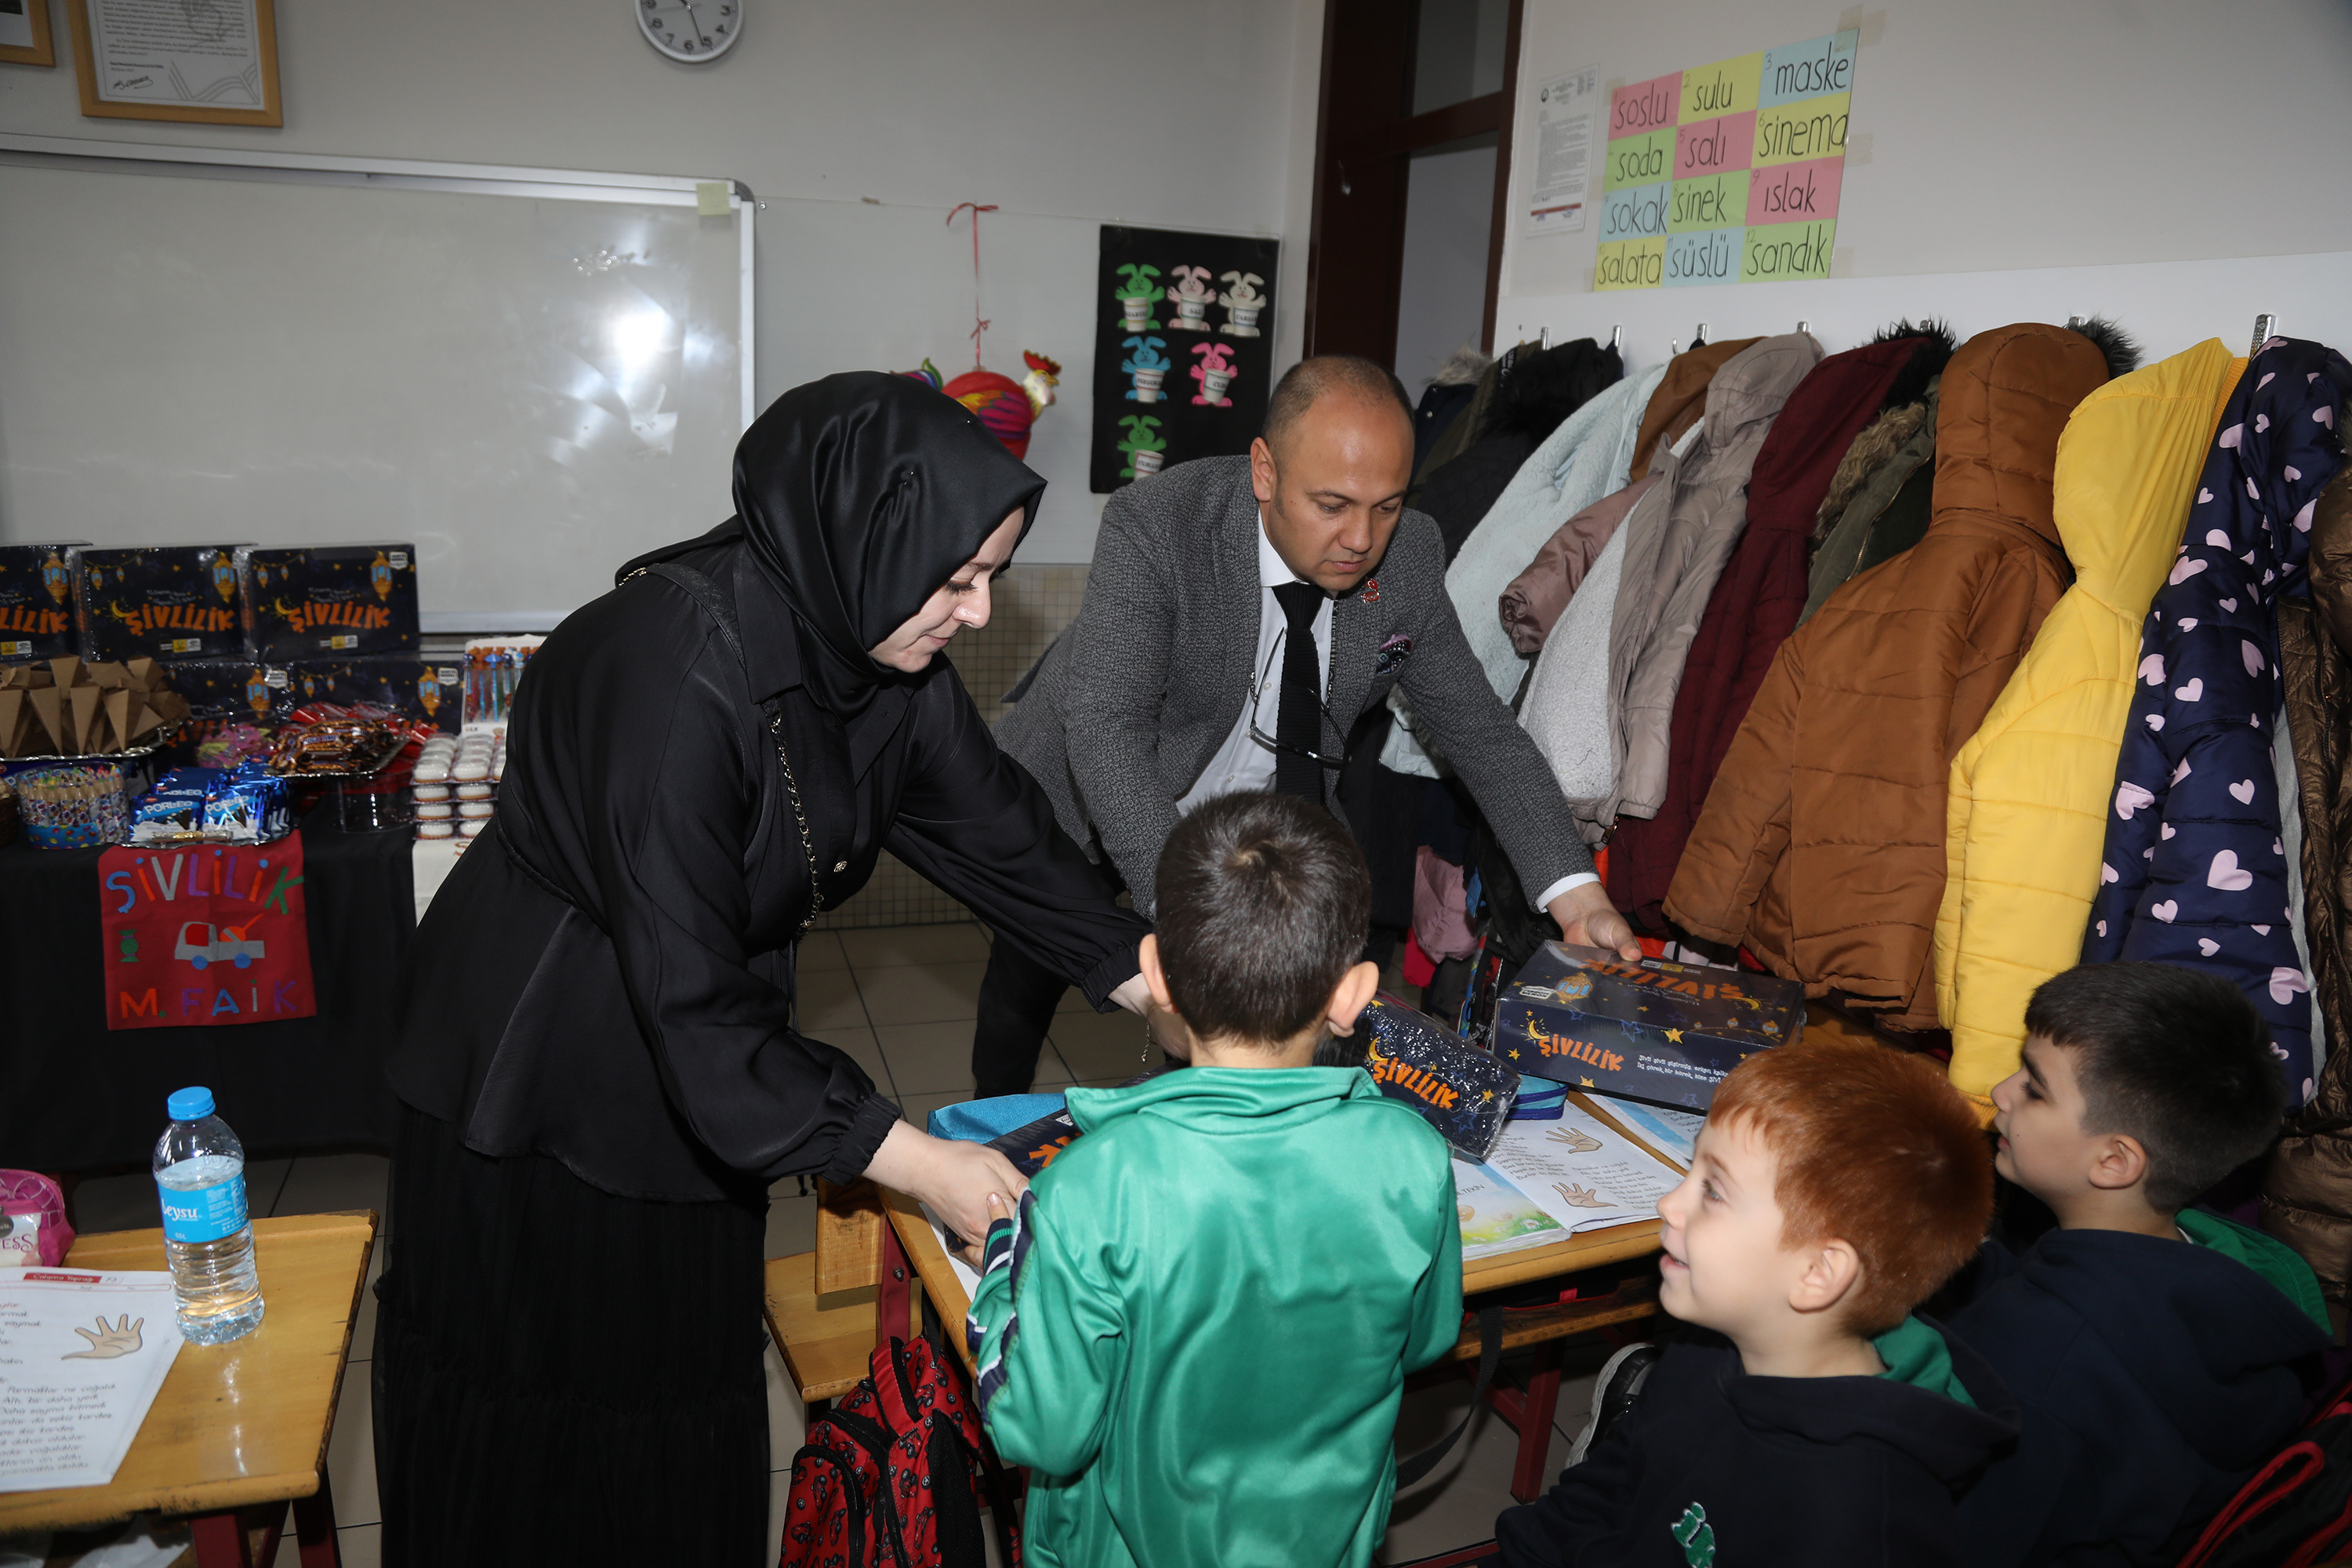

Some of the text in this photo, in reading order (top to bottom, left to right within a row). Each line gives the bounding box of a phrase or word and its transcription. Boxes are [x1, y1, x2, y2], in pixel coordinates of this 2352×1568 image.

[720, 5, 731, 16] 3
[666, 33, 675, 44] 7
[684, 40, 695, 52] 6
[1775, 41, 1849, 96] maske
[1615, 82, 1668, 129] soslu
[1693, 70, 1733, 112] sulu
[1686, 119, 1726, 168] salı
[1759, 114, 1849, 158] sinema
[1617, 136, 1664, 182] soda
[1607, 184, 1668, 234] sokak
[1673, 176, 1726, 223] sinek
[1765, 168, 1817, 213] ıslak
[1599, 242, 1663, 285] salata
[1669, 232, 1730, 278] süslü
[1747, 223, 1828, 276] sandık
[125, 603, 235, 637] ŞİVLİLİK
[287, 601, 390, 633] ŞİVLİLİK
[106, 849, 305, 914] ŞİVLİLİK
[182, 979, 297, 1017] FAİK
[1538, 1033, 1624, 1072] ŞİVLİLİK
[1373, 1057, 1459, 1110] ŞİVLİLİK
[162, 1197, 199, 1221] beysu
[0, 1233, 34, 1253] ESS
